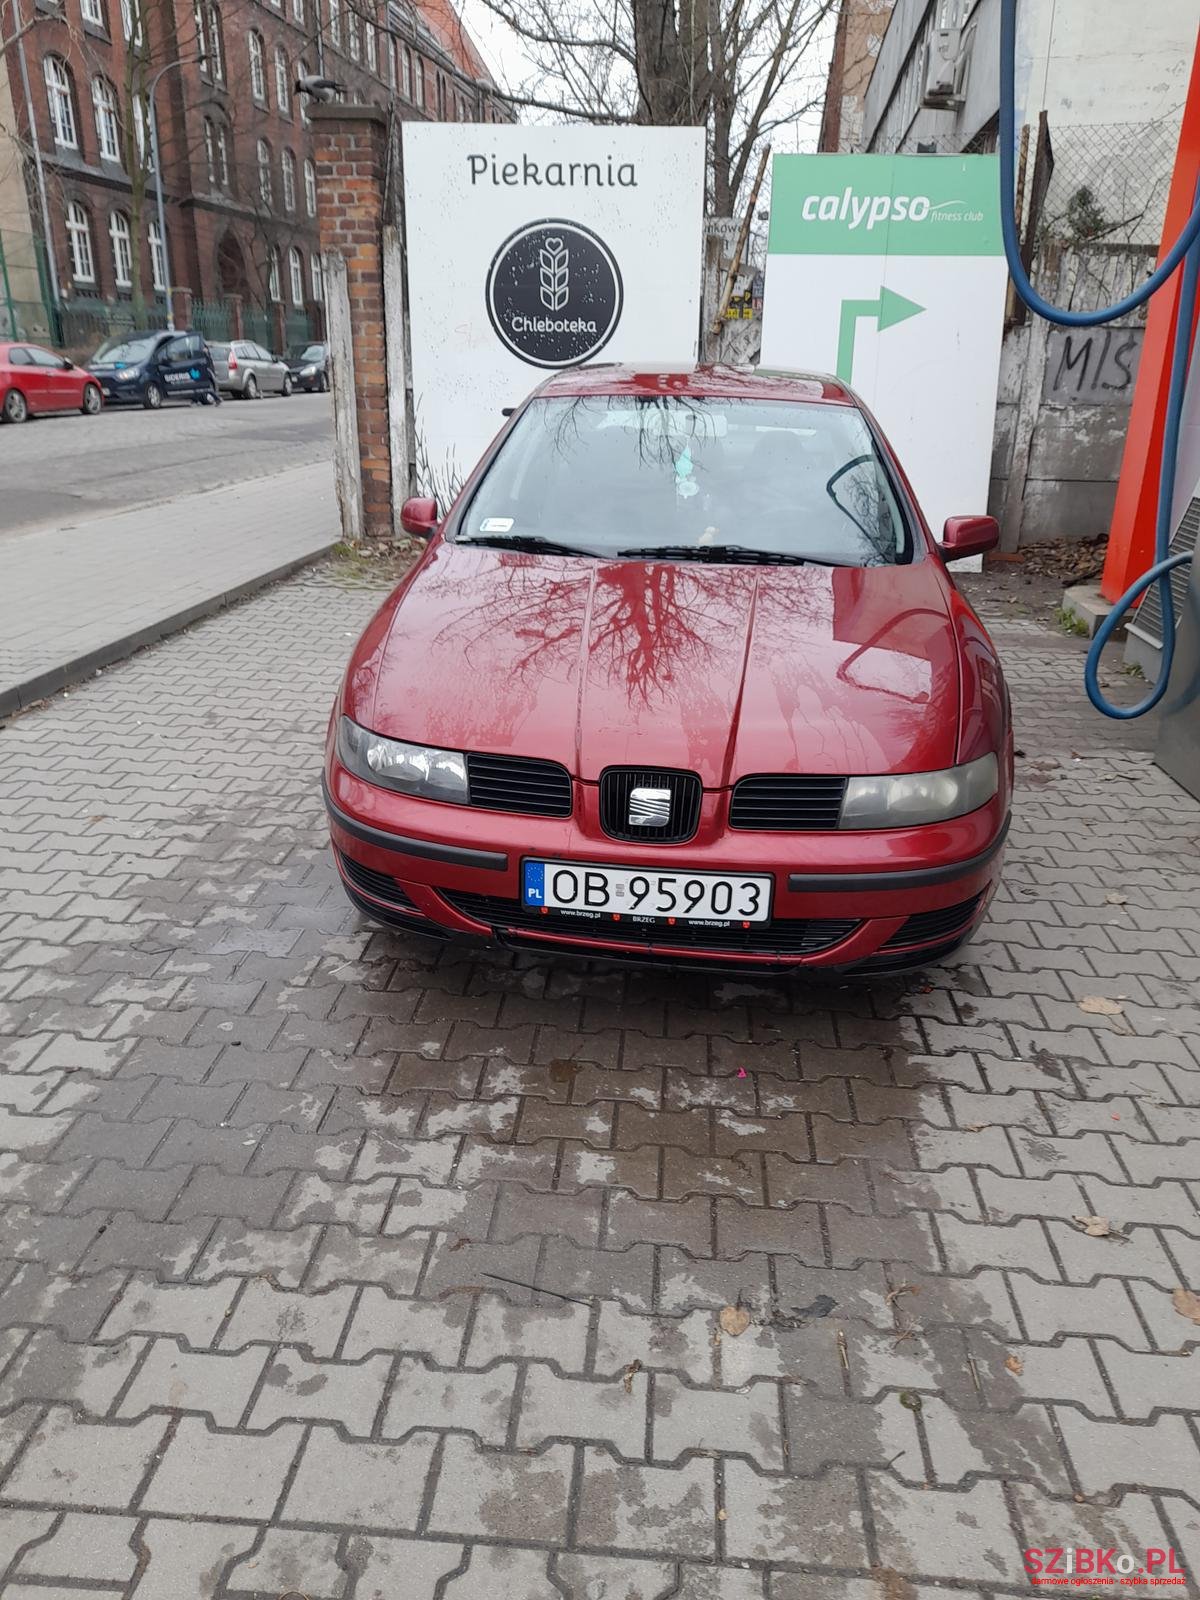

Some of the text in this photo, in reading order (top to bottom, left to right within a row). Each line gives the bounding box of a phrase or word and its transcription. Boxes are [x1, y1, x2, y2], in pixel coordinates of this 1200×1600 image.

[467, 153, 638, 186] Piekarnia
[801, 186, 930, 230] calypso
[930, 209, 984, 222] fitness club
[511, 316, 597, 333] Chleboteka
[528, 888, 543, 899] PL
[553, 869, 761, 916] OB 95903
[560, 909, 601, 919] www.brzeg.pl
[632, 915, 656, 924] BRZEG
[688, 919, 731, 928] www.brzeg.pl
